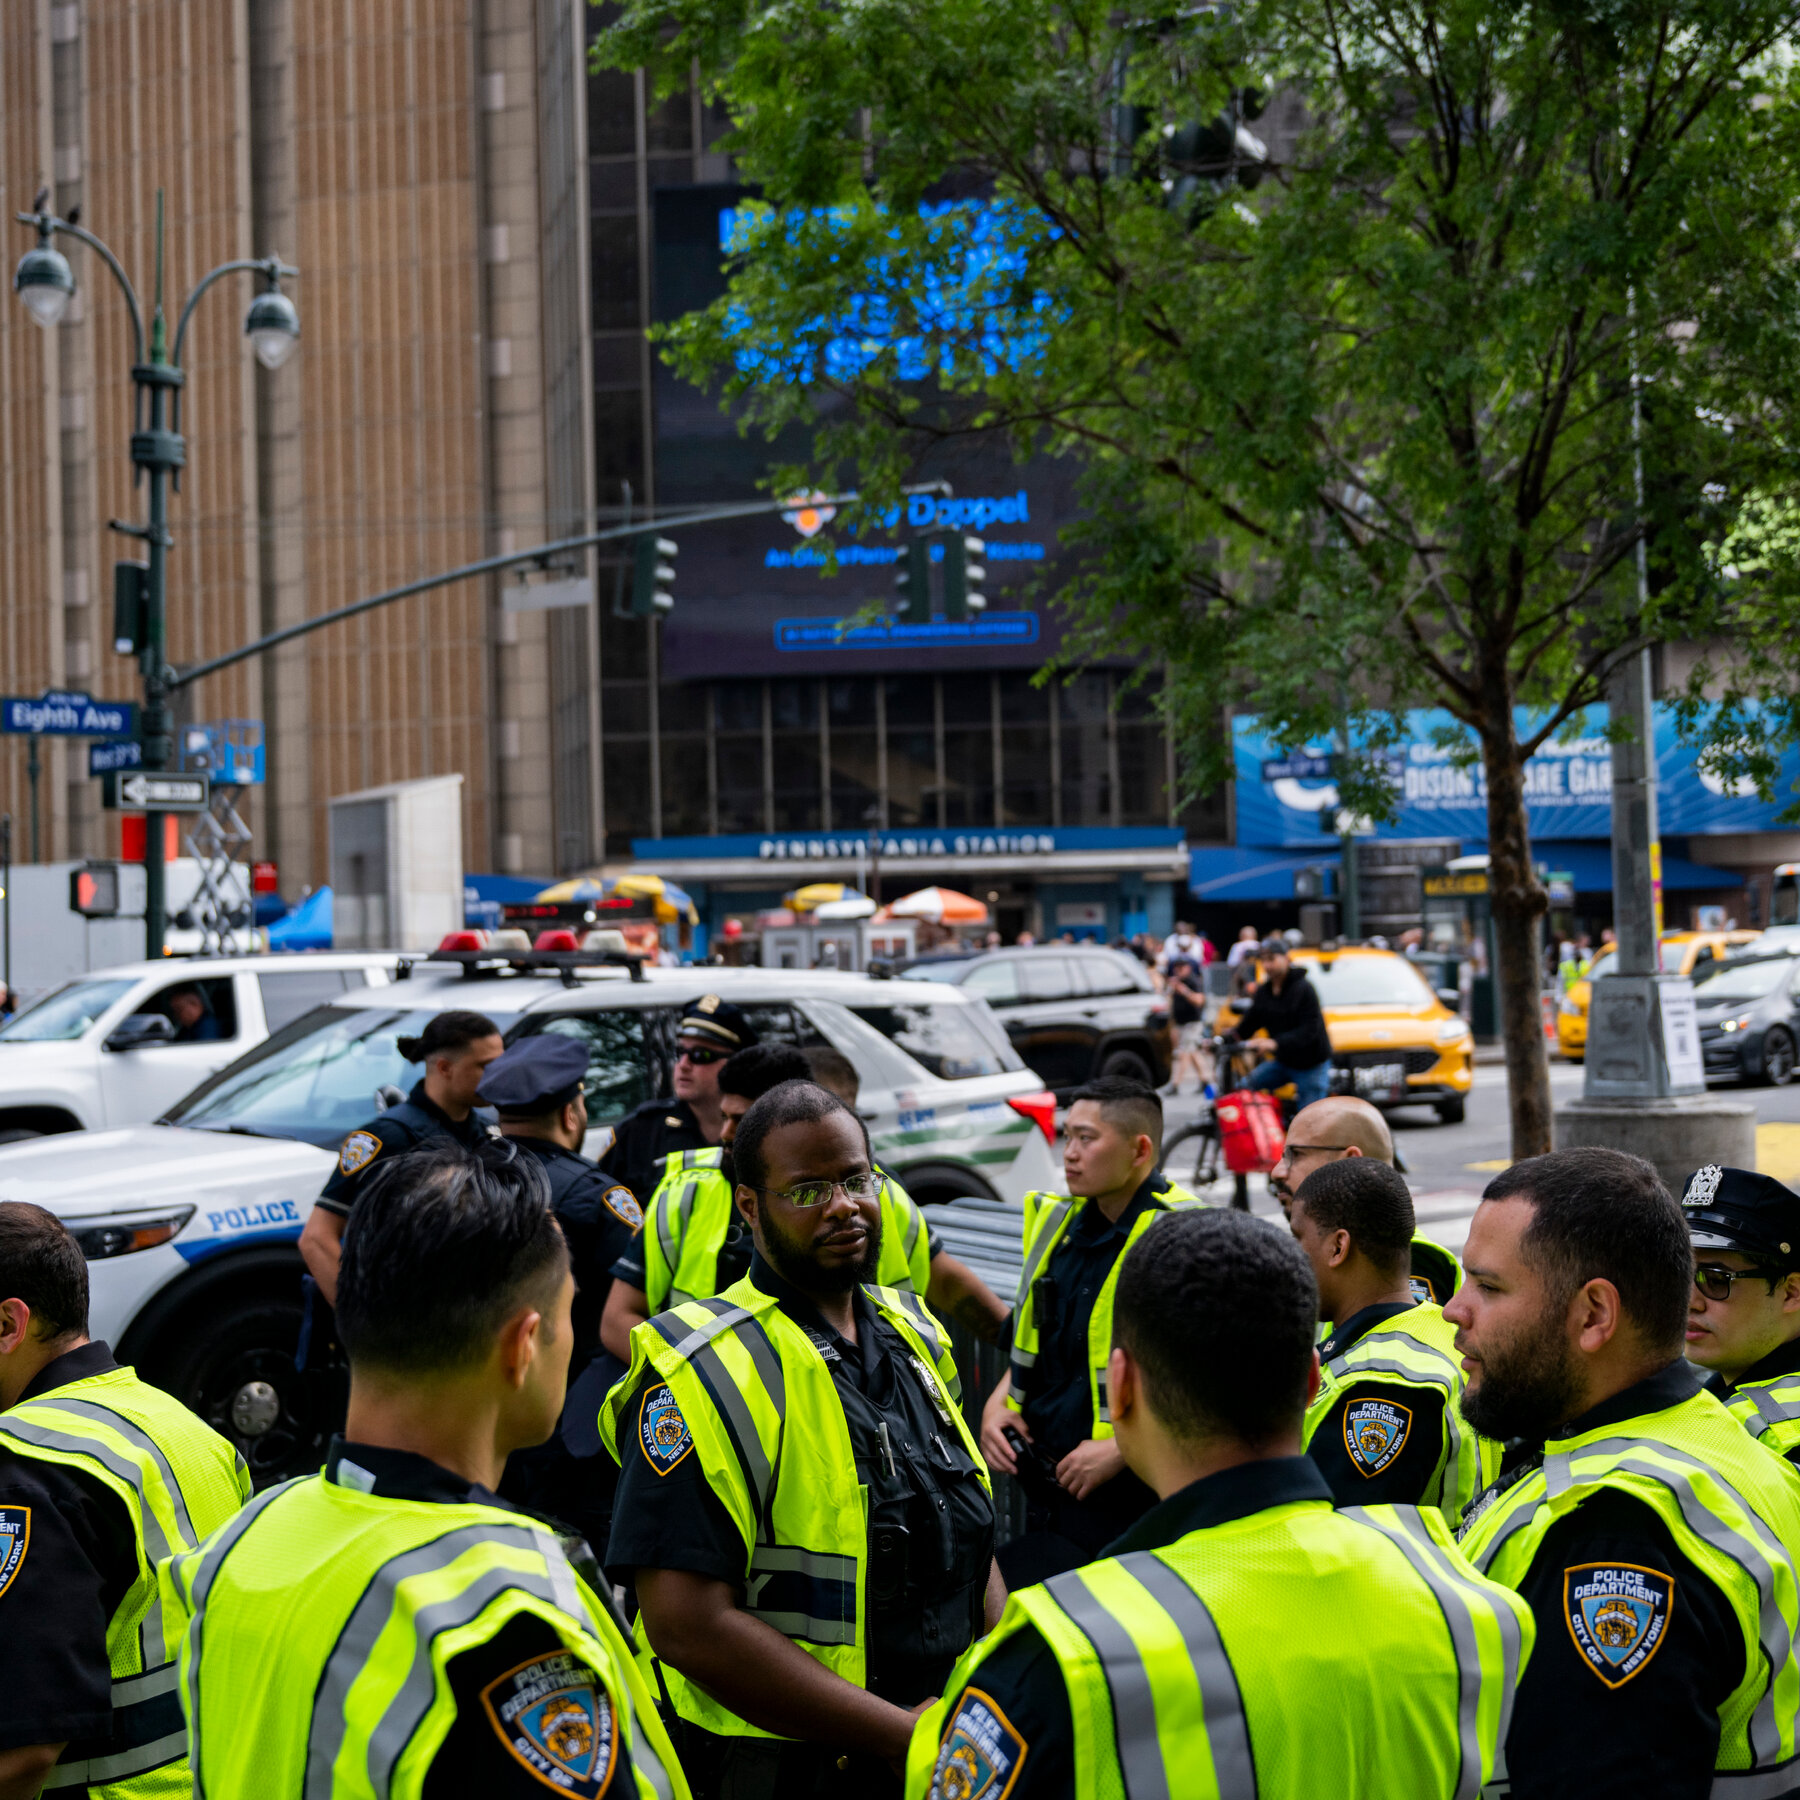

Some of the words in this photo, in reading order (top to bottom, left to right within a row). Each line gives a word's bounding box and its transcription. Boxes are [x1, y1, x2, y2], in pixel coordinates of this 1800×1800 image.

[12, 702, 78, 732] Eighth
[83, 706, 122, 730] Ave
[954, 835, 1055, 855] STATION
[207, 1199, 299, 1232] POLICE
[646, 1396, 678, 1412] DEPAR
[1349, 1410, 1405, 1428] DEPARTMENT
[1362, 1403, 1394, 1414] POLICE
[643, 1422, 652, 1444] CITY
[649, 1445, 658, 1457] OF
[667, 1443, 685, 1462] NEW
[1347, 1429, 1357, 1449] CITY
[1353, 1450, 1364, 1462] OF
[1374, 1453, 1390, 1470] NEW
[1388, 1433, 1405, 1455] YORK
[5, 1539, 24, 1571] YORK
[1574, 1582, 1663, 1606] DEPARTMENT
[1593, 1570, 1645, 1586] POLICE
[1572, 1613, 1591, 1645] CITY
[1586, 1646, 1604, 1665] OF
[1622, 1647, 1646, 1674] NEW
[1642, 1614, 1665, 1649] YORK
[513, 1654, 573, 1691] POLICE
[500, 1668, 597, 1723] DEPARTMENT
[515, 1736, 551, 1771] CITY
[549, 1766, 575, 1788] OF
